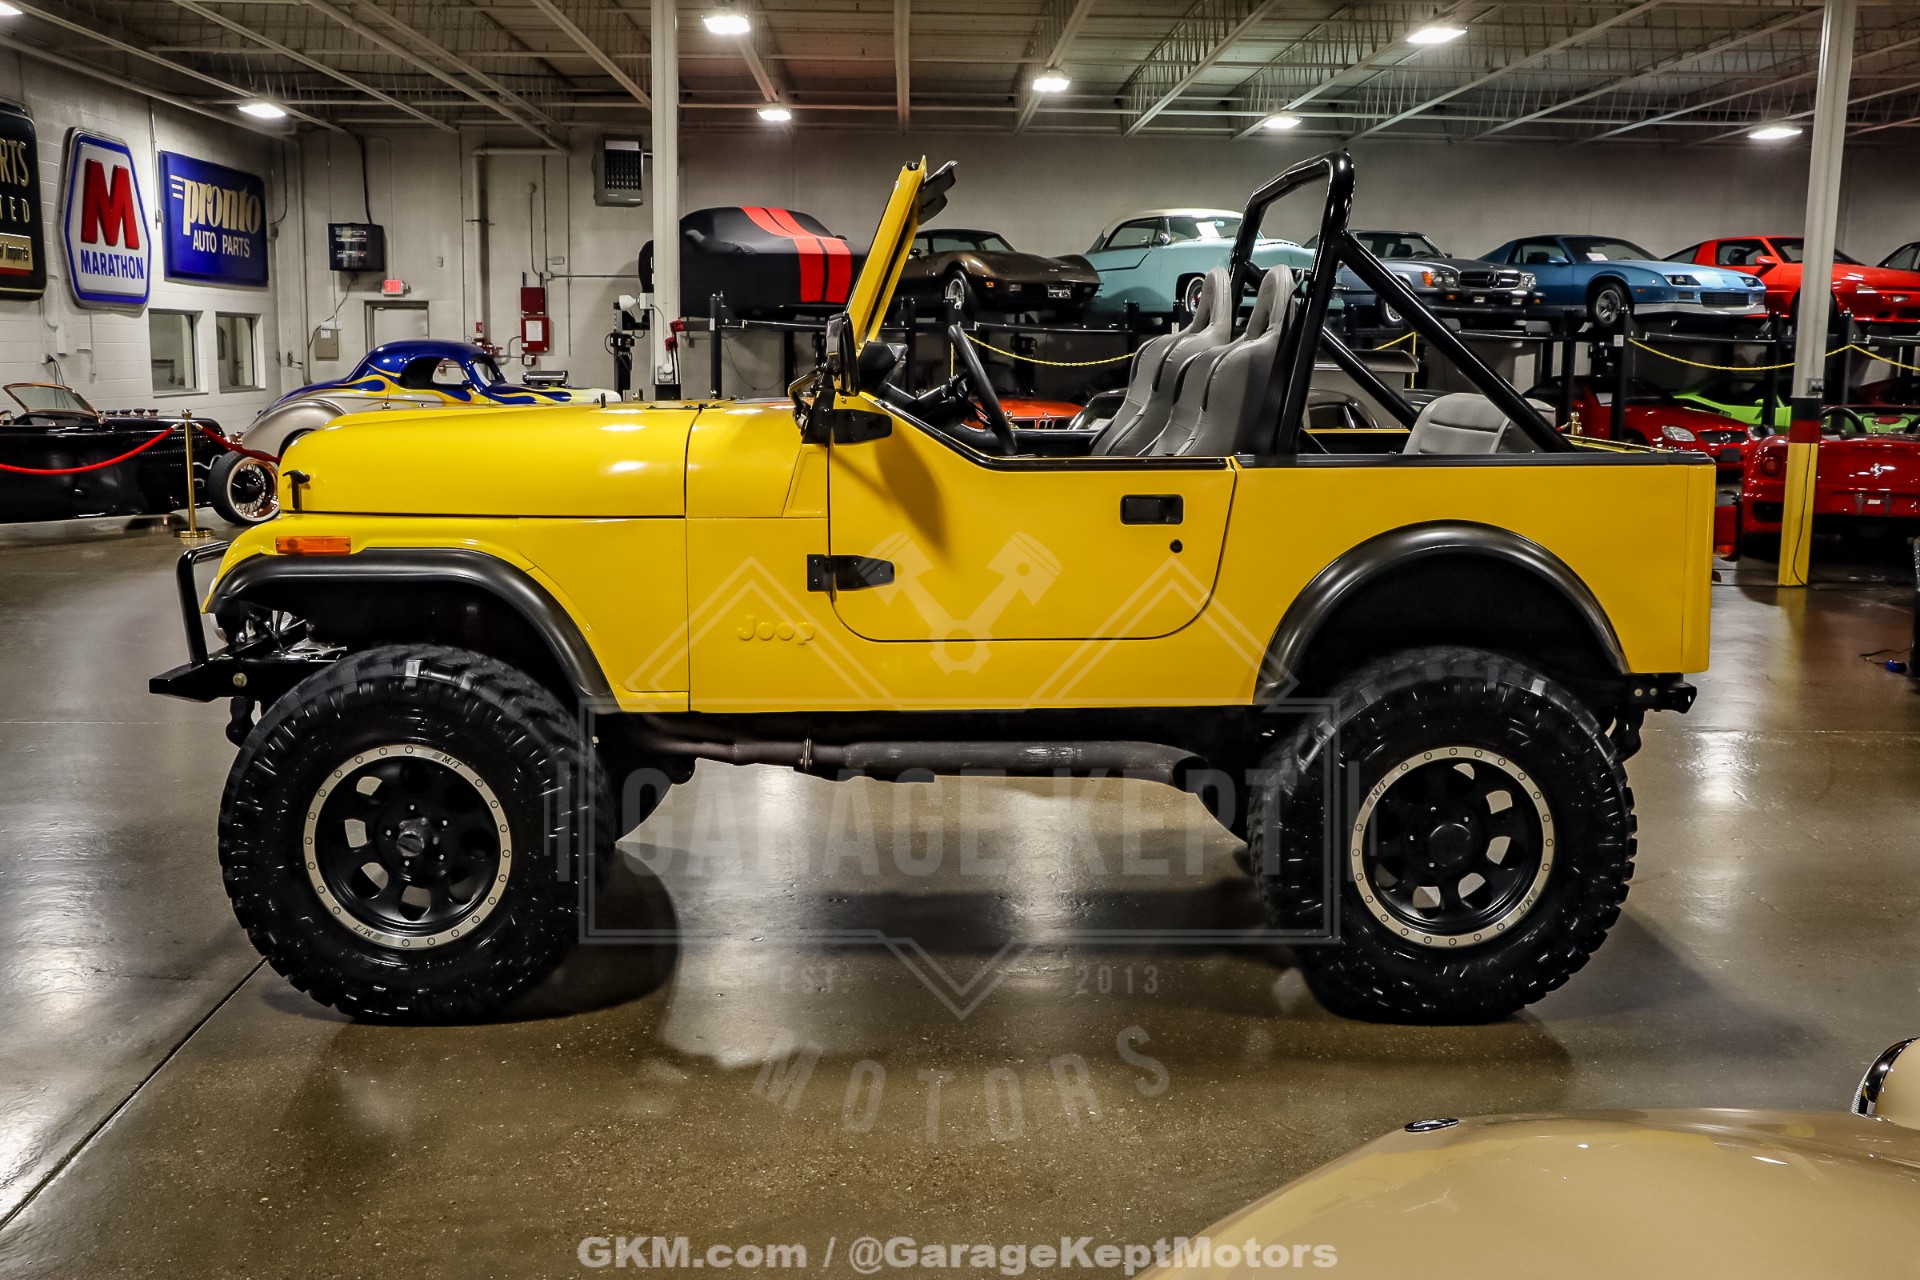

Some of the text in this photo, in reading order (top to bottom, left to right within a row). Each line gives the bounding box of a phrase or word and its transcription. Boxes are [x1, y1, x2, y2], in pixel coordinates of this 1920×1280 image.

[81, 159, 139, 249] M
[182, 177, 261, 235] pronto
[193, 229, 250, 258] AUTO PARTS
[80, 249, 145, 280] MARATHON
[385, 280, 400, 293] EXIT
[441, 755, 463, 769] M/T
[1371, 779, 1387, 799] M/T
[353, 924, 374, 938] M/T
